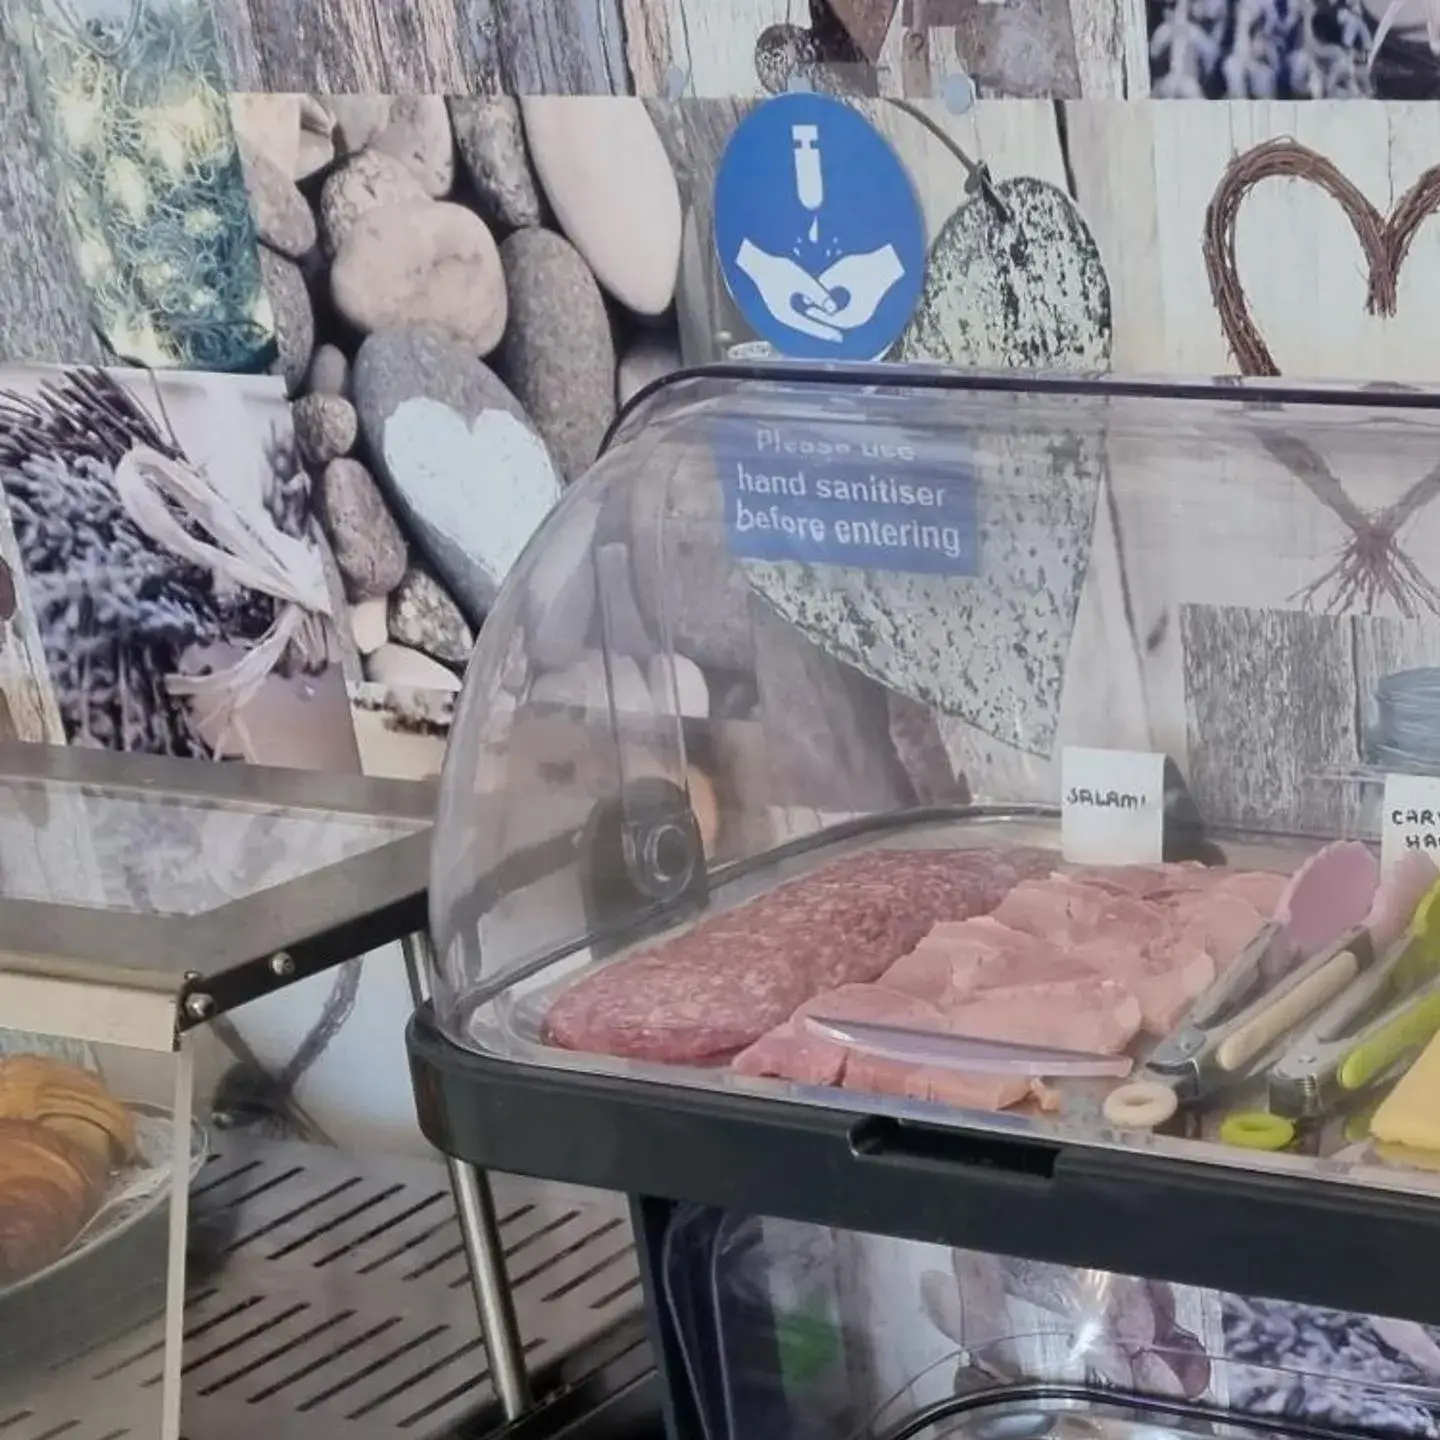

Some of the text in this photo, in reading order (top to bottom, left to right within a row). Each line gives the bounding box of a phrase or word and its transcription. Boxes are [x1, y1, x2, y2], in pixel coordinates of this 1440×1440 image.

[736, 461, 947, 508] hand sanitiser
[735, 499, 961, 559] before entering
[1066, 787, 1146, 811] SALAMI
